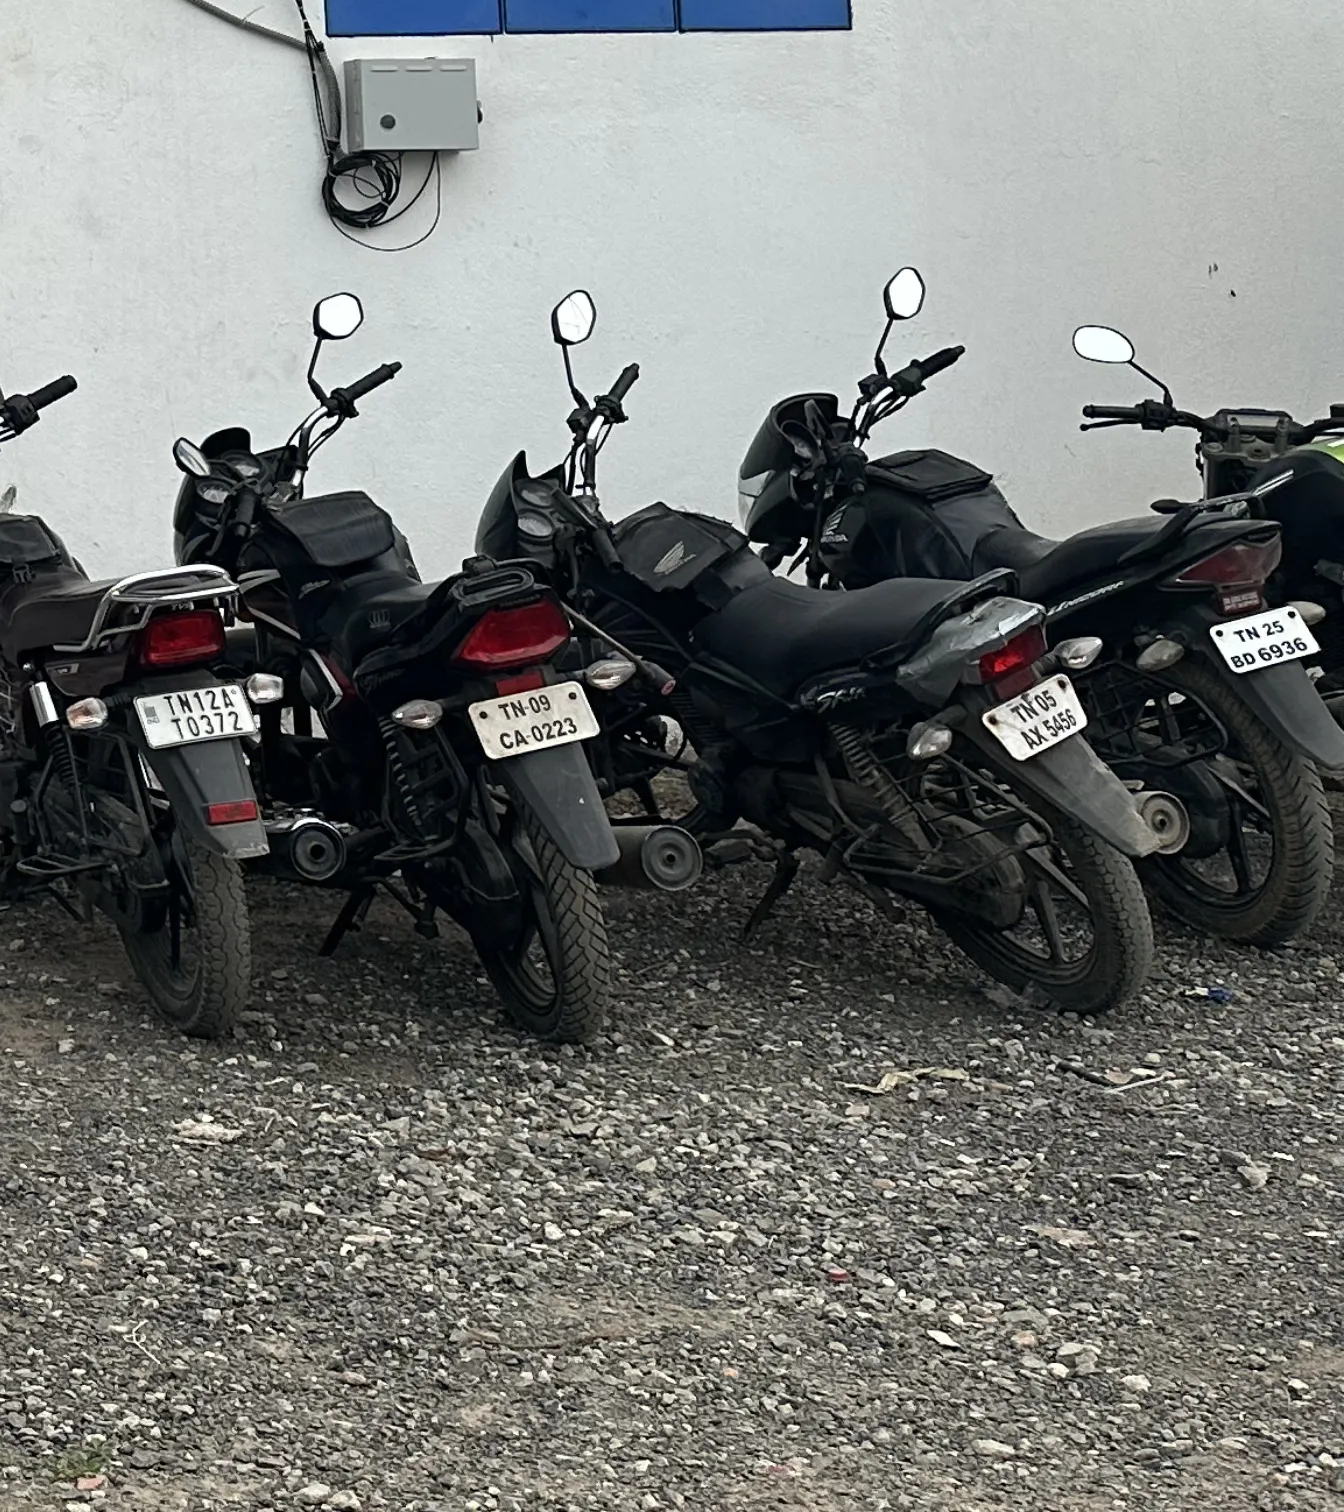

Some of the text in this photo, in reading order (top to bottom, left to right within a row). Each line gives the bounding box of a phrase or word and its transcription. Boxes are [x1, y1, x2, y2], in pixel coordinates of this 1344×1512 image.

[1233, 620, 1285, 643] TN 25
[1230, 637, 1308, 669] BD 6936
[164, 688, 236, 716] TN12A
[497, 694, 552, 721] TN-09
[1010, 689, 1057, 724] TN 05
[171, 711, 244, 740] T0372
[499, 717, 578, 750] CA-0223
[1020, 707, 1077, 751] AX 5456
